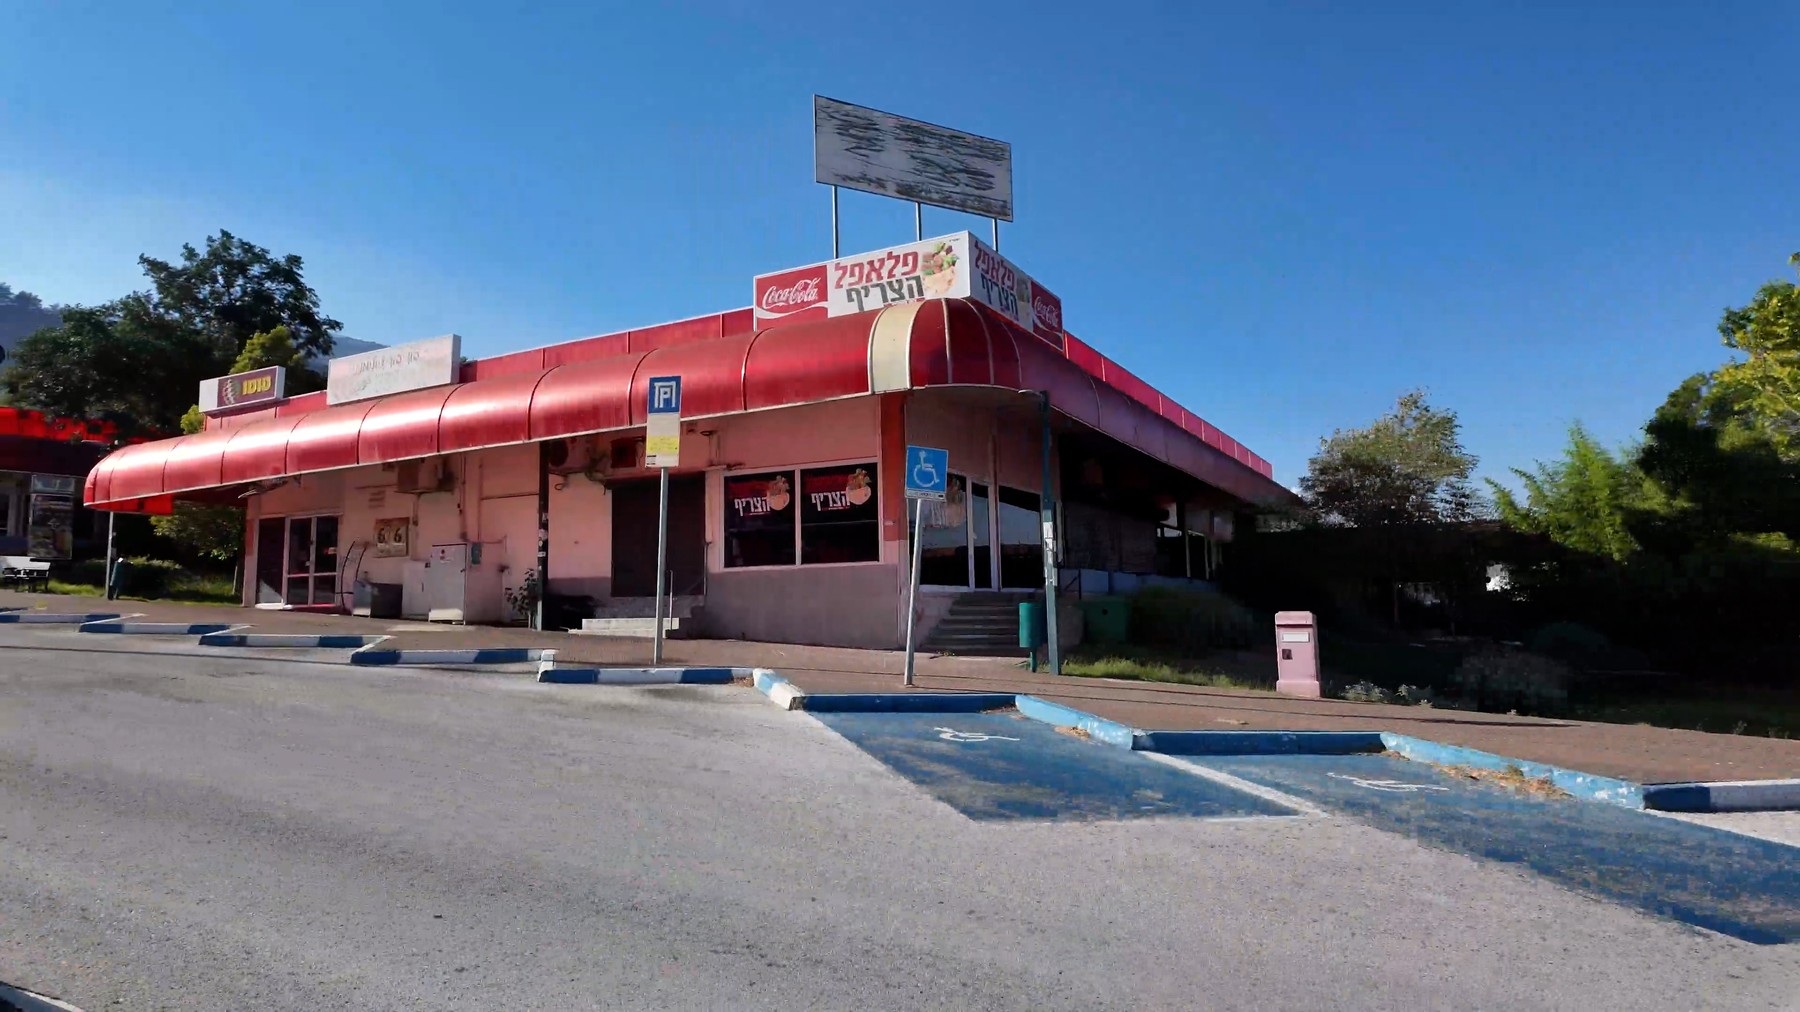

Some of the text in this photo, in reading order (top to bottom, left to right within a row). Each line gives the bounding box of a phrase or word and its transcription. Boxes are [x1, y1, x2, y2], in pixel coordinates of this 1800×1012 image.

[835, 250, 919, 289] פלאפל
[974, 239, 1015, 291] פלאפל
[763, 277, 820, 309] Coca-Cola
[846, 275, 925, 312] הצריף
[980, 272, 1020, 321] הצריף
